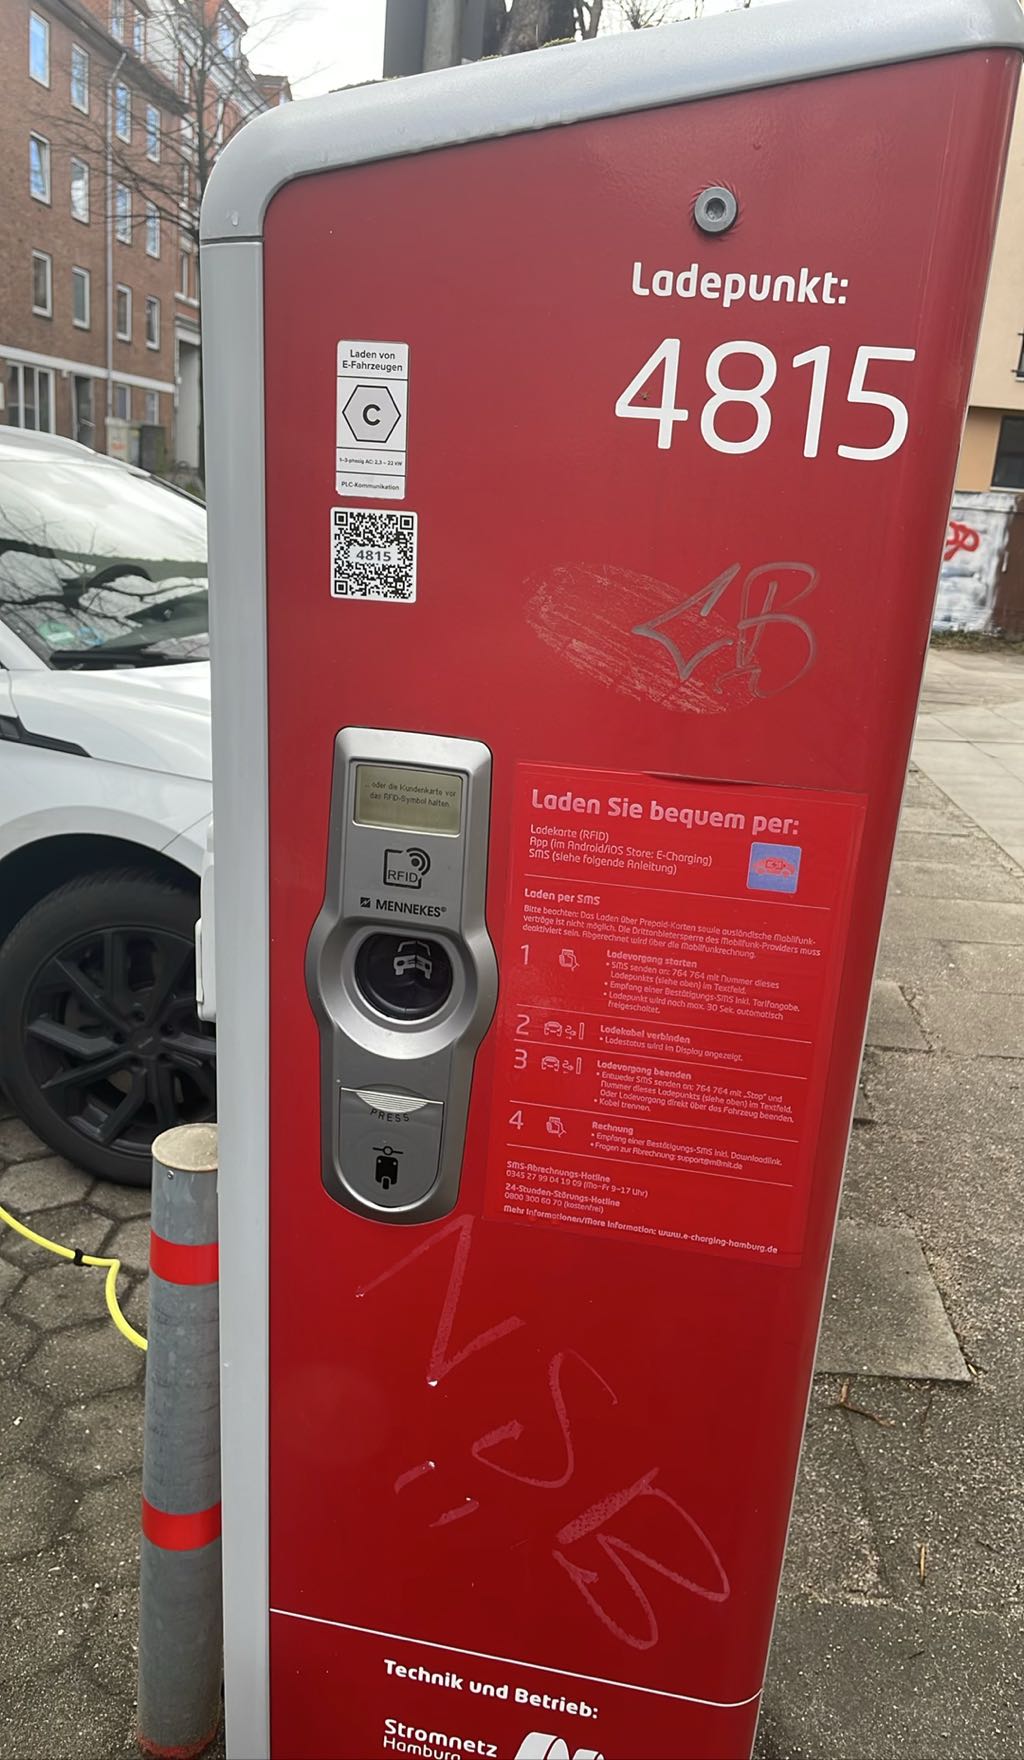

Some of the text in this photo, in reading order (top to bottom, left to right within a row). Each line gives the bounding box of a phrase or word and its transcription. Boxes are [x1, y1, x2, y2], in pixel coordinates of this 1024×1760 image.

[631, 261, 849, 308] Ladepunkt:
[350, 349, 396, 360] Laden von
[342, 360, 403, 373] E-Fahrzeugen
[614, 338, 917, 461] 4815
[362, 403, 381, 426] C
[341, 481, 400, 490] PLC-Kommunikation
[356, 549, 392, 562] 4815
[532, 788, 799, 835] Laden Sie bequem per:
[530, 823, 609, 842] Ladekarte (RFID)
[529, 835, 712, 866] App (im Android/iOS Store: E-Charging)
[528, 848, 550, 859] SMS
[582, 853, 624, 868] folgende
[626, 859, 676, 875] Anleitung)
[387, 869, 419, 883] RFID
[524, 887, 600, 905] Laden per SMS
[520, 944, 529, 965] 1
[606, 949, 697, 968] Ladevorgang starten
[516, 1014, 530, 1035] 2
[600, 1024, 690, 1044] Ladekabel verbinden
[513, 1048, 527, 1069] 3
[596, 1059, 691, 1080] Ladevorgang beenden
[370, 1108, 410, 1123] PRESS
[508, 1110, 523, 1129] 4
[591, 1121, 633, 1135] Rechnung
[506, 1160, 610, 1182] SMS-Abrechnungs-Hotline
[505, 1182, 620, 1207] 24-Stunden-Störungs-Hotline
[503, 1204, 524, 1214] Mehr
[607, 1220, 656, 1234] Information:
[657, 1229, 778, 1253] www.e-charging-hamburg.de
[383, 1658, 599, 1720] Technik und Betrieb:
[384, 1718, 498, 1758] Stromnetz
